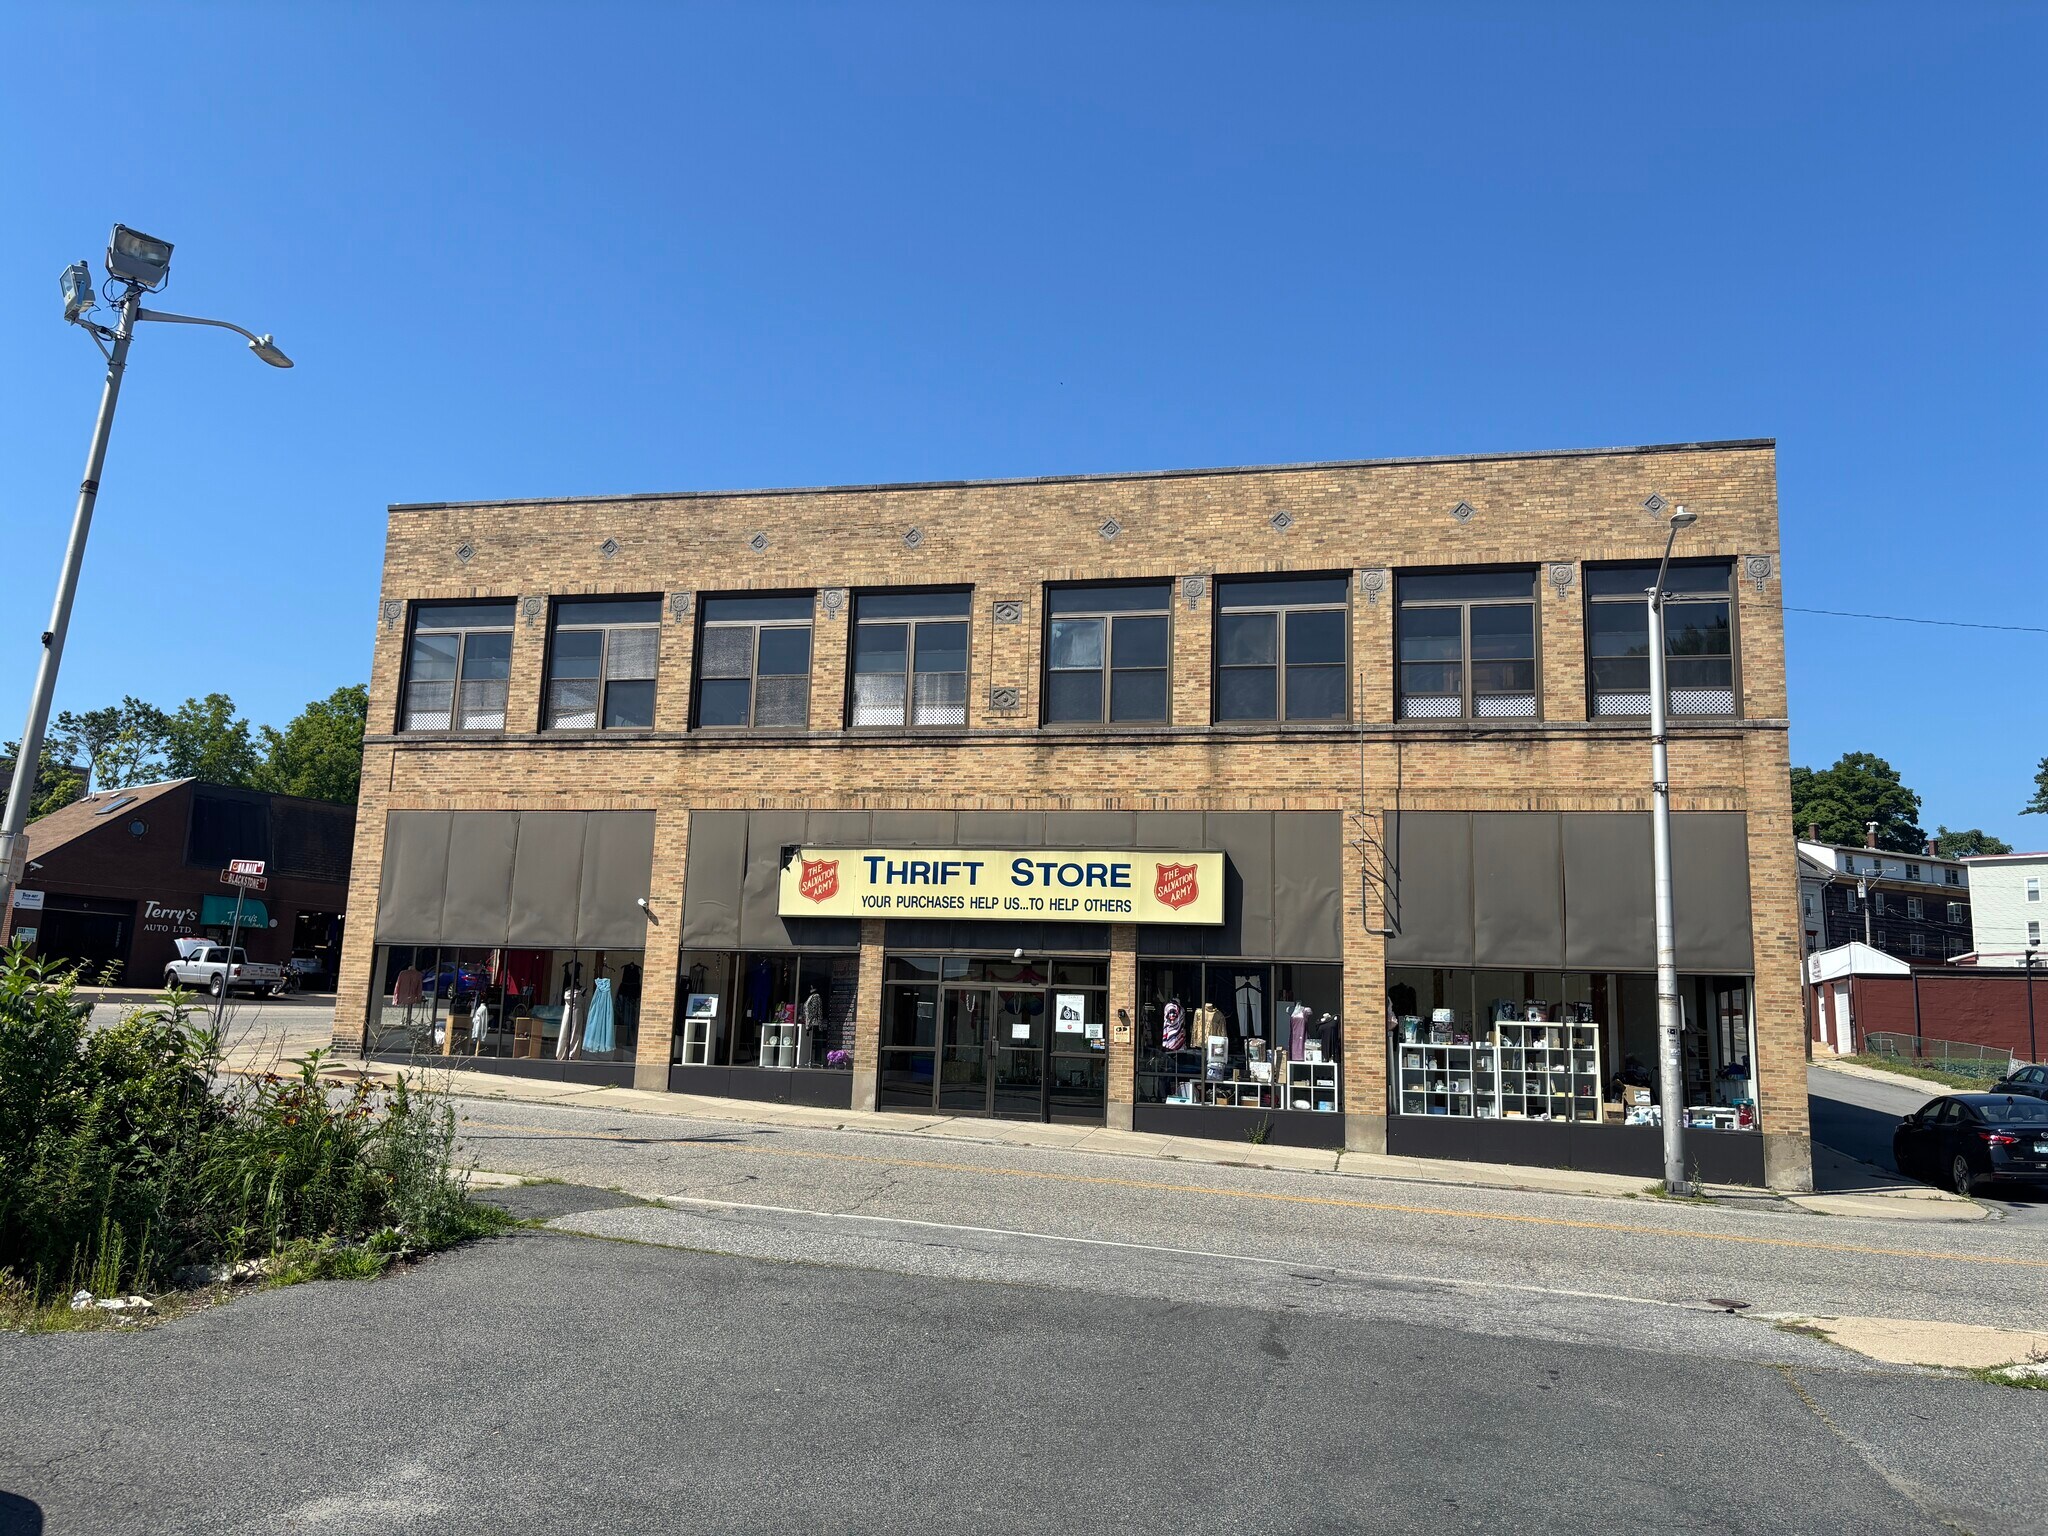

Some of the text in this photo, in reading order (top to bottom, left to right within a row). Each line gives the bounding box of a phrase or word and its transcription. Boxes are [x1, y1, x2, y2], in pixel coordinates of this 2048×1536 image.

[802, 865, 835, 892] SALVATION
[807, 863, 823, 877] THE
[863, 855, 1132, 888] THRIFT STORE
[1163, 867, 1180, 882] THE
[228, 873, 260, 888] BLACKSTONE
[812, 877, 834, 897] ARMY
[1157, 869, 1193, 898] SALVATION
[1170, 882, 1192, 902] ARMY
[144, 900, 198, 925] Terry's
[861, 895, 891, 908] YOUR
[896, 895, 965, 909] PURCHASES
[970, 896, 999, 910] HELP
[1049, 898, 1079, 911] HELP
[1084, 898, 1132, 913] OTHERS
[143, 924, 169, 932] AUTO
